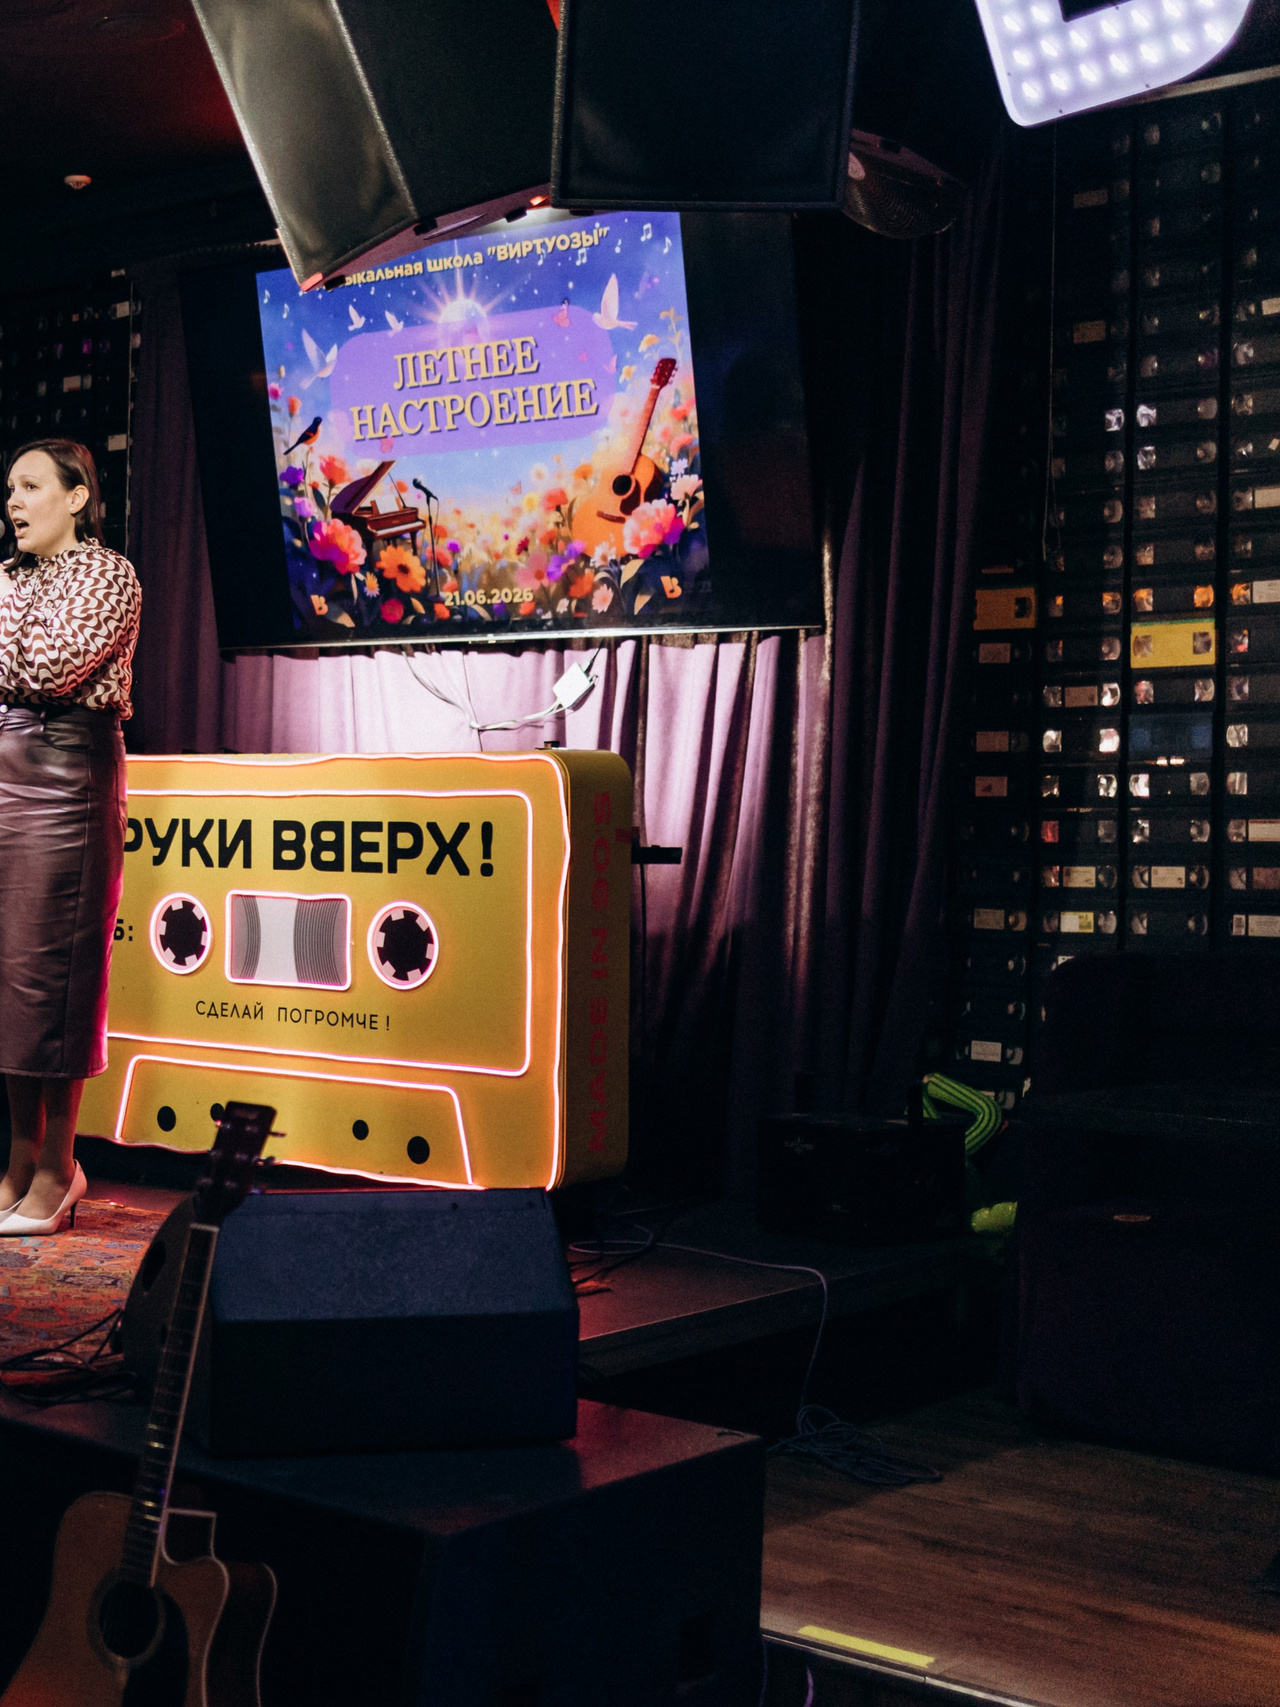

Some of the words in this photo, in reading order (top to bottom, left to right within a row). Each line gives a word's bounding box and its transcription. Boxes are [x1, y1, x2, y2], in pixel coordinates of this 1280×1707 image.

[317, 260, 424, 291] ыкальная
[427, 251, 484, 273] школа
[487, 227, 610, 262] "ВИРТУОЗЫ"
[393, 336, 539, 390] ЛЕТНЕЕ
[350, 378, 599, 440] НАСТРОЕНИЕ
[445, 587, 534, 606] 21.06.2026
[273, 820, 494, 877] ВВЕРХ!
[591, 927, 608, 978] IN
[195, 1000, 264, 1020] СДЕЛАЙ
[589, 995, 608, 1153] MADE
